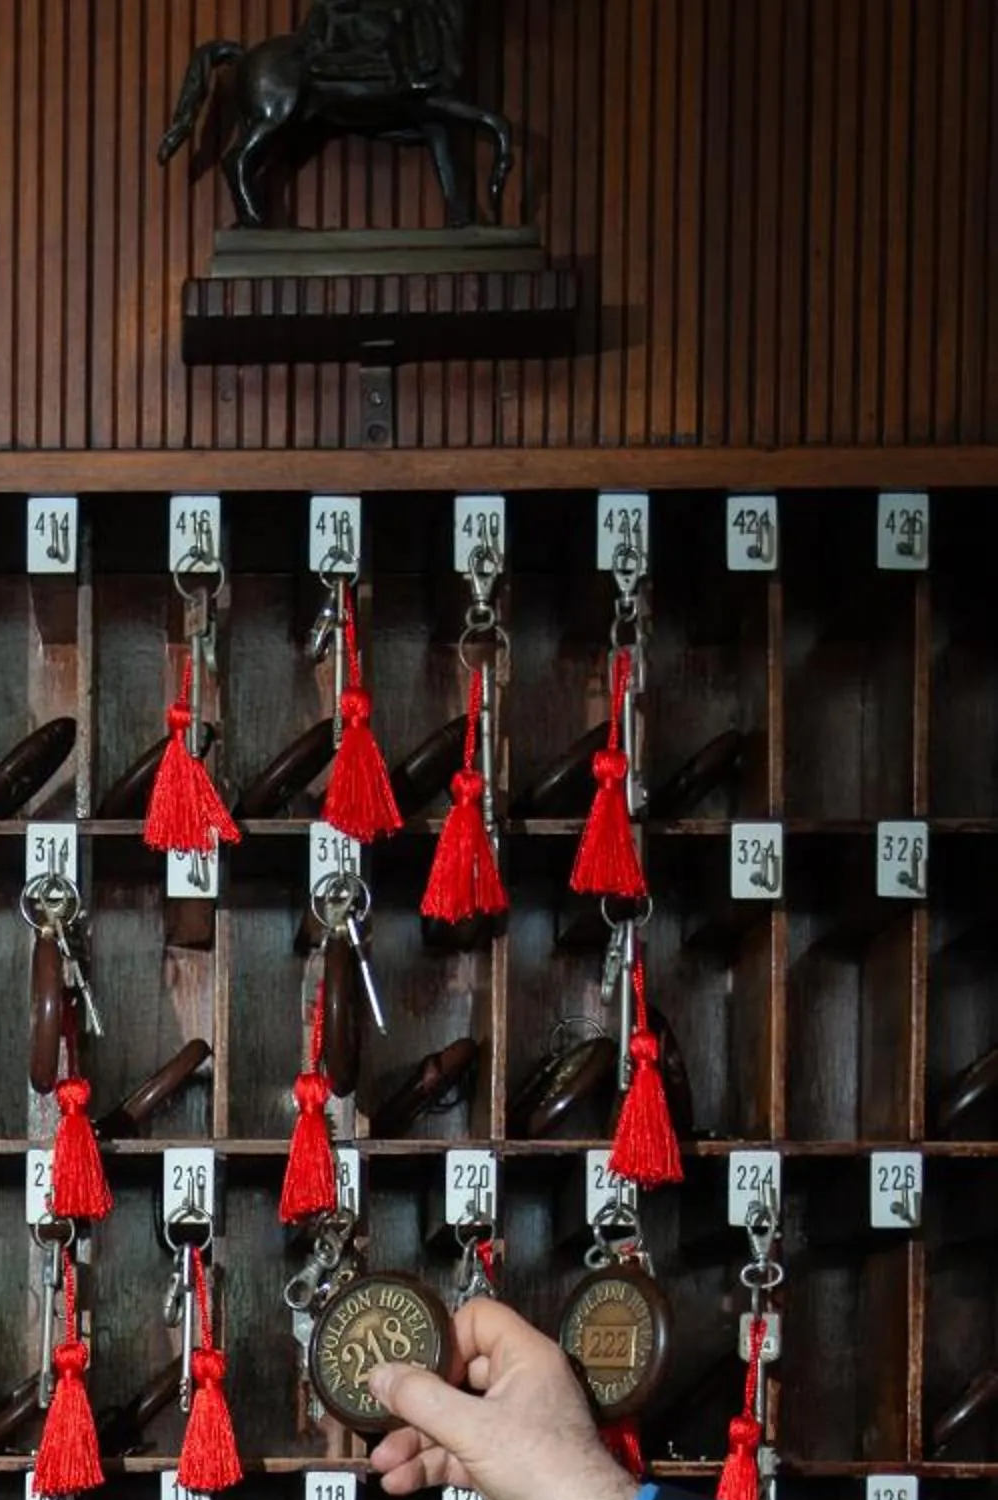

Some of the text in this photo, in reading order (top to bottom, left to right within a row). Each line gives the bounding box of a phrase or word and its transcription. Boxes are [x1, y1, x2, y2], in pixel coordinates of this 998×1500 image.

[35, 512, 70, 536] 414
[176, 510, 211, 533] 416
[462, 513, 500, 537] 420
[603, 509, 642, 533] 422
[733, 509, 770, 534] 424
[885, 510, 923, 534] 426
[35, 837, 69, 861] 314
[737, 838, 775, 864] 324
[882, 836, 924, 862] 326
[173, 1166, 207, 1190] 216
[454, 1165, 489, 1189] 220
[737, 1165, 774, 1190] 224
[878, 1166, 915, 1191] 226
[320, 1288, 427, 1393] NAPOLEON HOTEL
[589, 1331, 629, 1359] 222
[341, 1317, 411, 1389] 218
